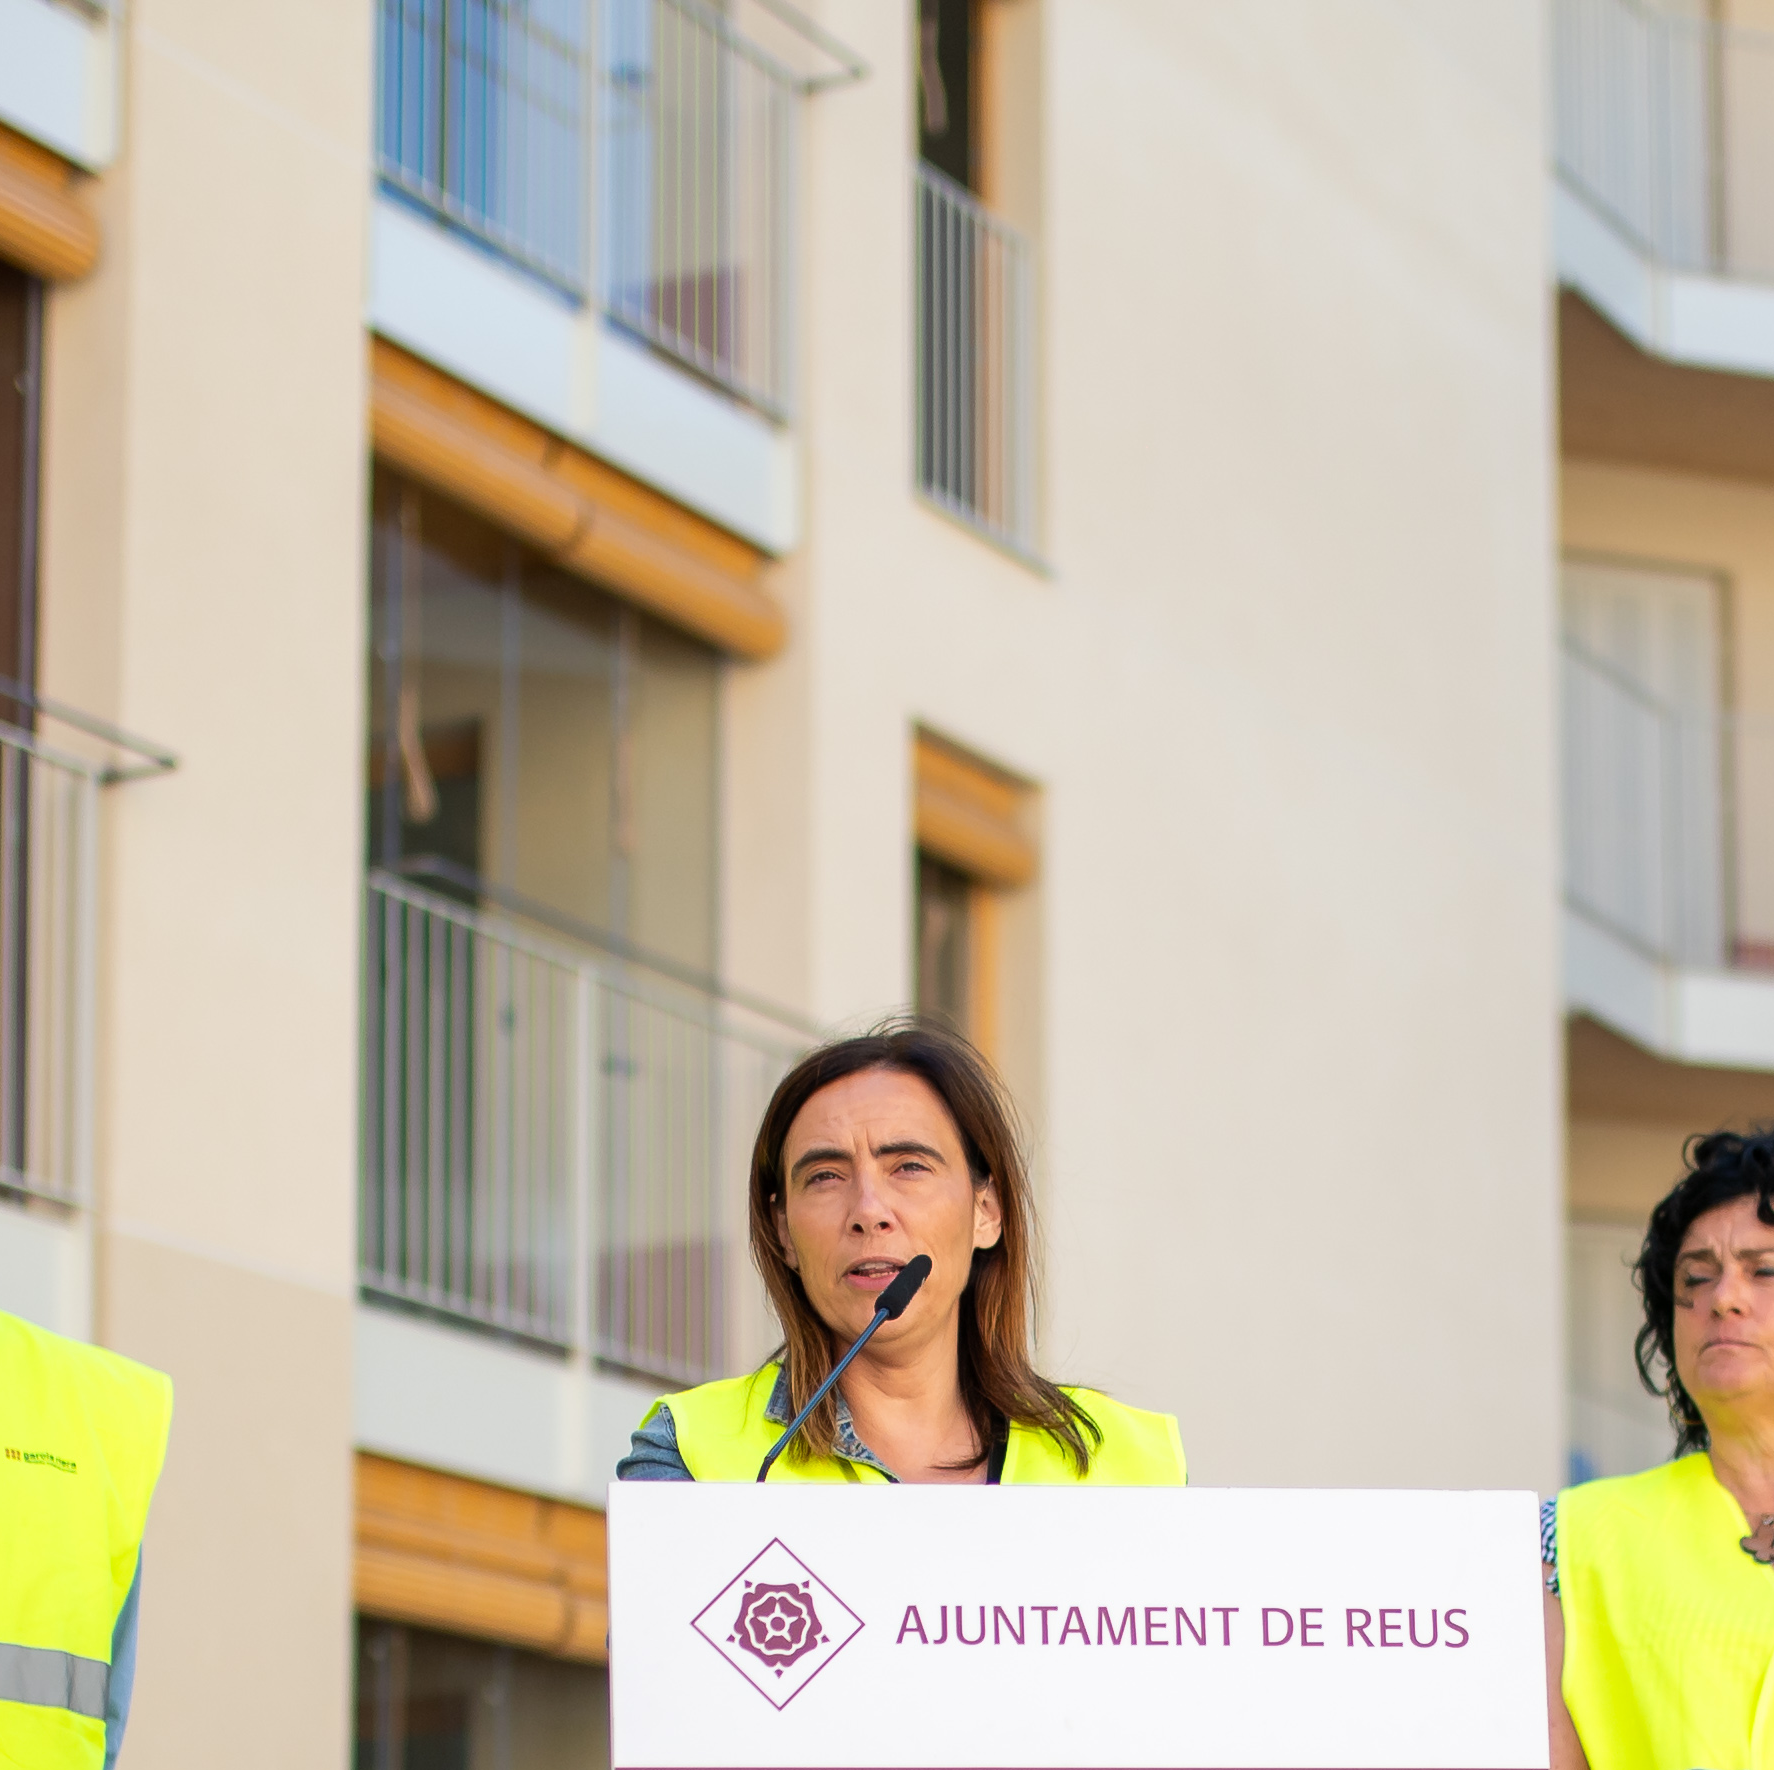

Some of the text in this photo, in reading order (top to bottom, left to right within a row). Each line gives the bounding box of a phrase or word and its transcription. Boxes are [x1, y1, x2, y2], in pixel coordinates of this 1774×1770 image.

[895, 1605, 1470, 1649] AJUNTAMENT DE REUS
